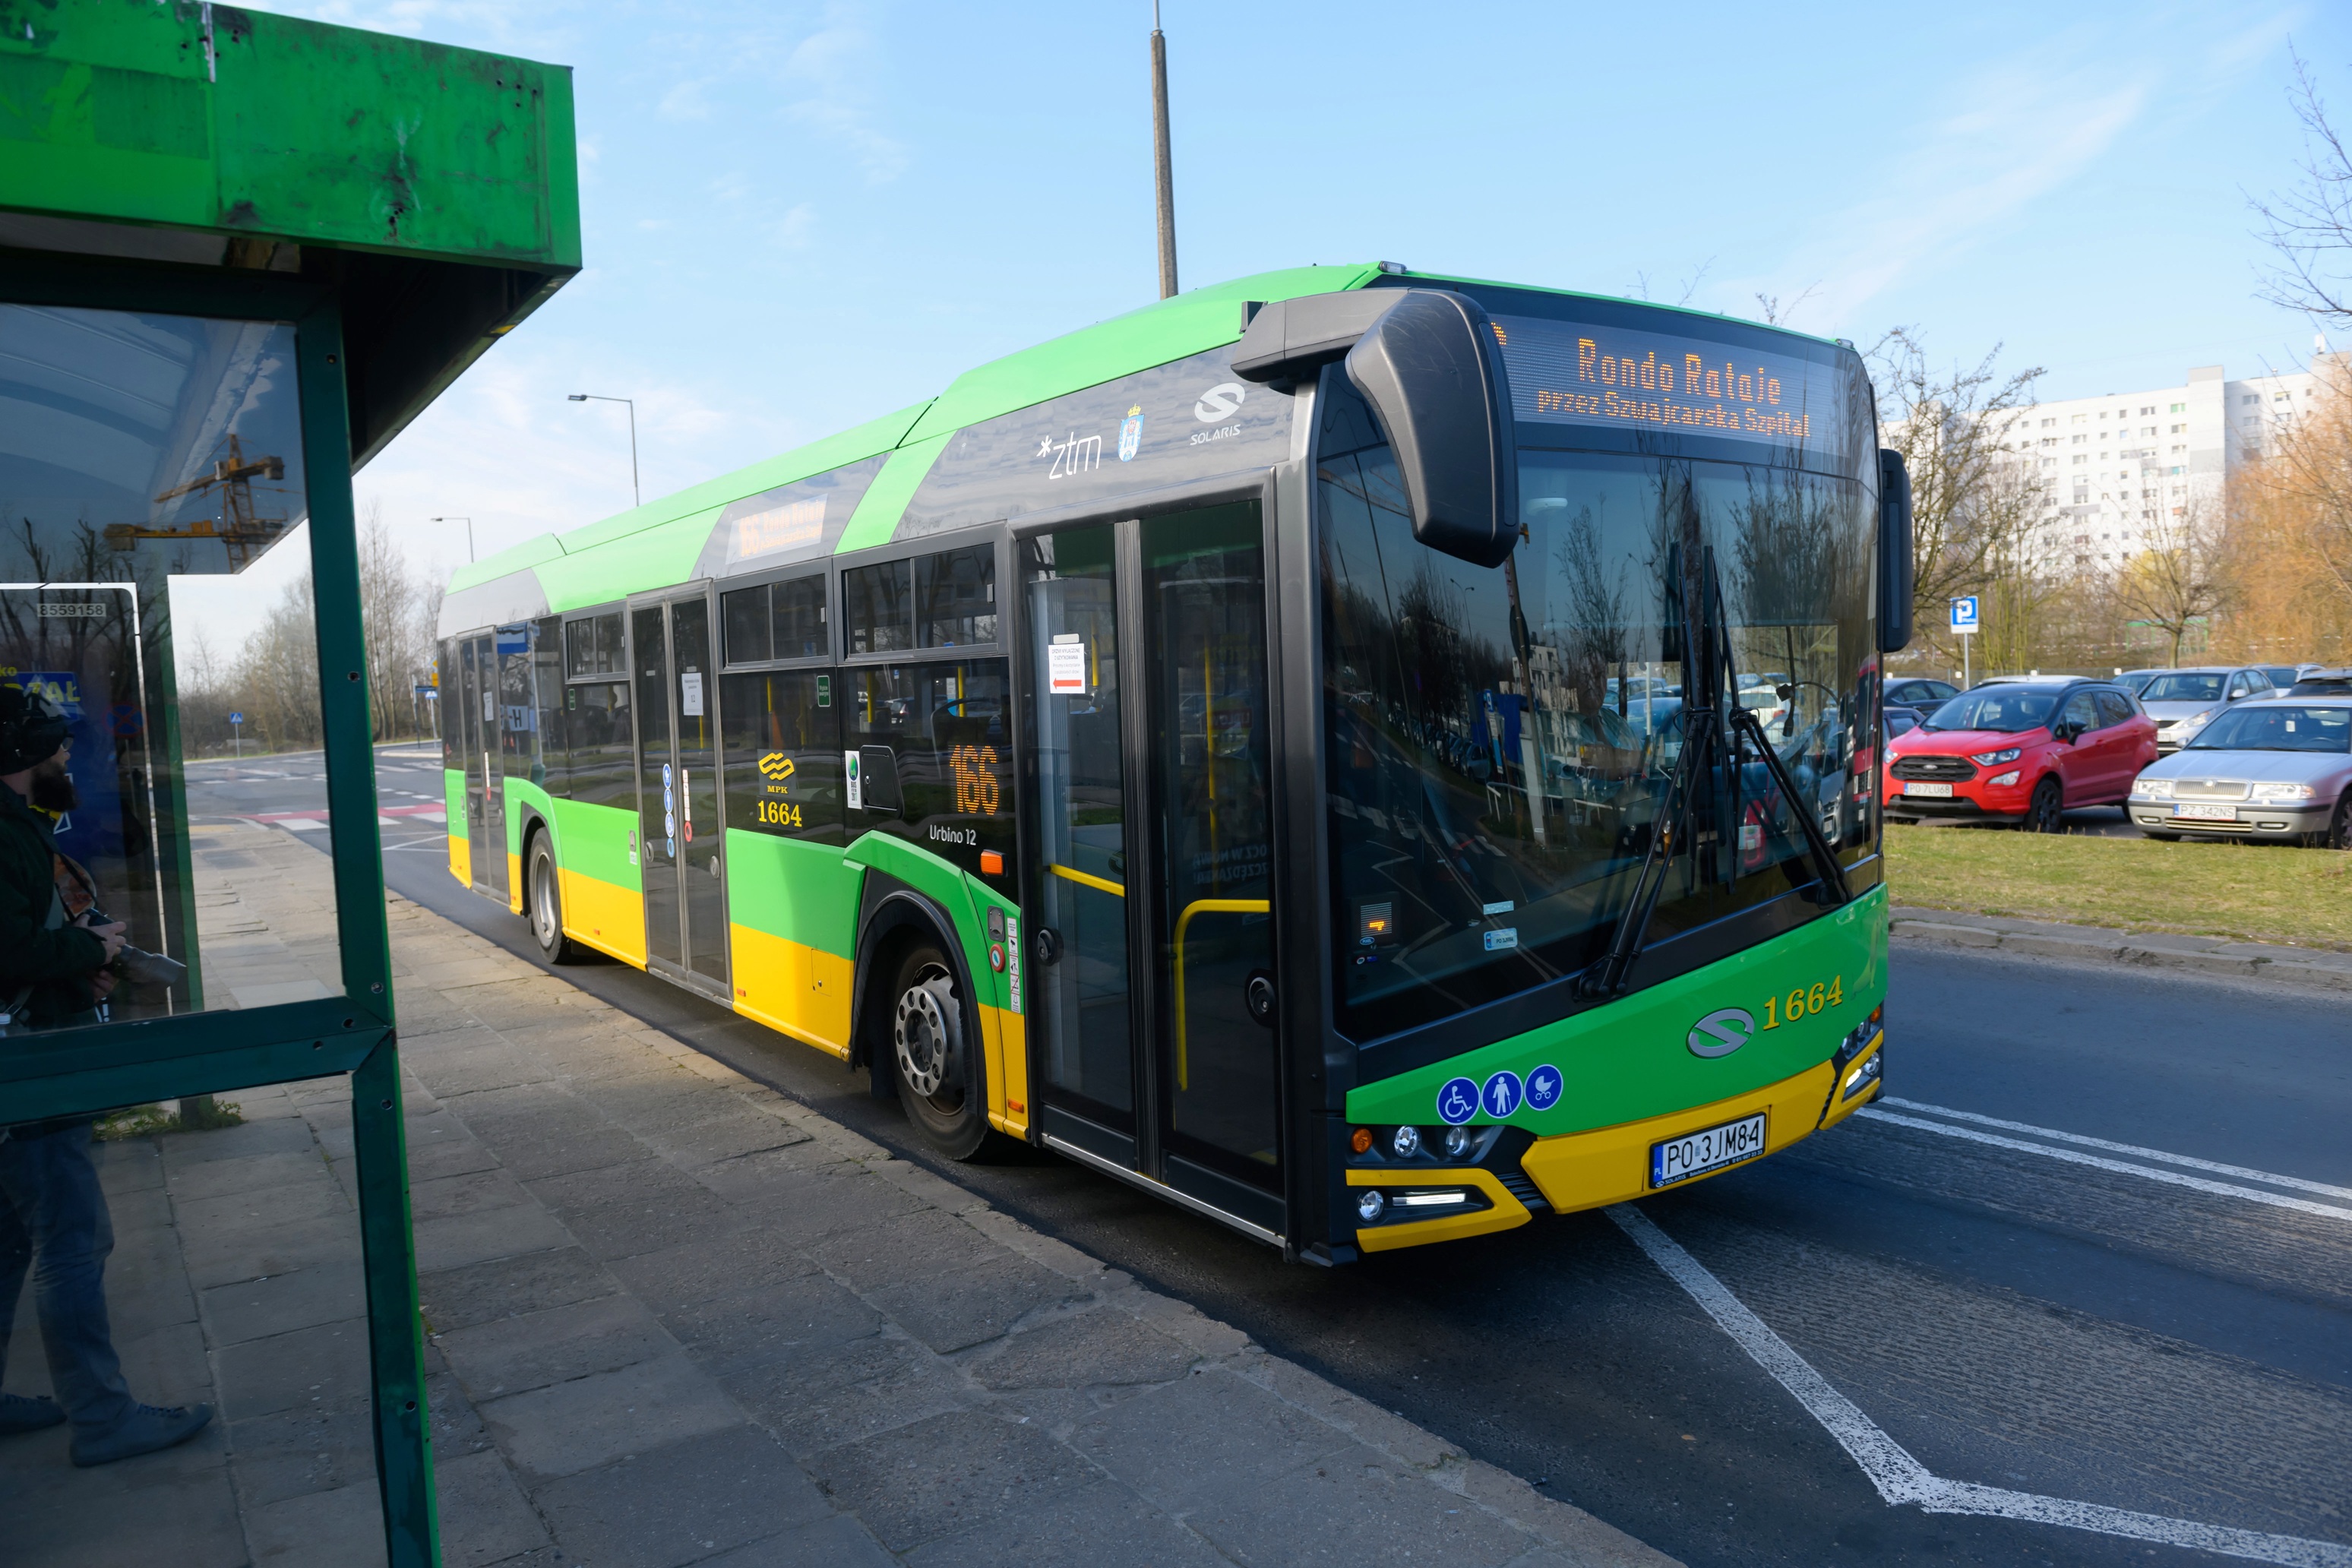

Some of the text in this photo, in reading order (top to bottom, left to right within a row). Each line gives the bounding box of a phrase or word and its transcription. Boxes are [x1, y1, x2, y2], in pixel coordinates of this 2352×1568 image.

[1578, 338, 1781, 406] Rondo Rataje
[1538, 390, 1811, 438] przez Szwajcarska Szpital
[1189, 423, 1241, 446] SOLARIS
[40, 605, 103, 616] 8559158
[767, 785, 789, 794] MPK
[949, 744, 999, 815] 166
[1923, 785, 1950, 794] 7LU68
[757, 800, 802, 827] 1664
[2180, 805, 2234, 817] PZ 342NS
[929, 824, 977, 846] Urbino 12
[1762, 975, 1843, 1031] 1664
[1666, 1119, 1760, 1174] PO 3JM84
[1654, 1167, 1662, 1176] PL
[1664, 1174, 1687, 1185] SOLARIS
